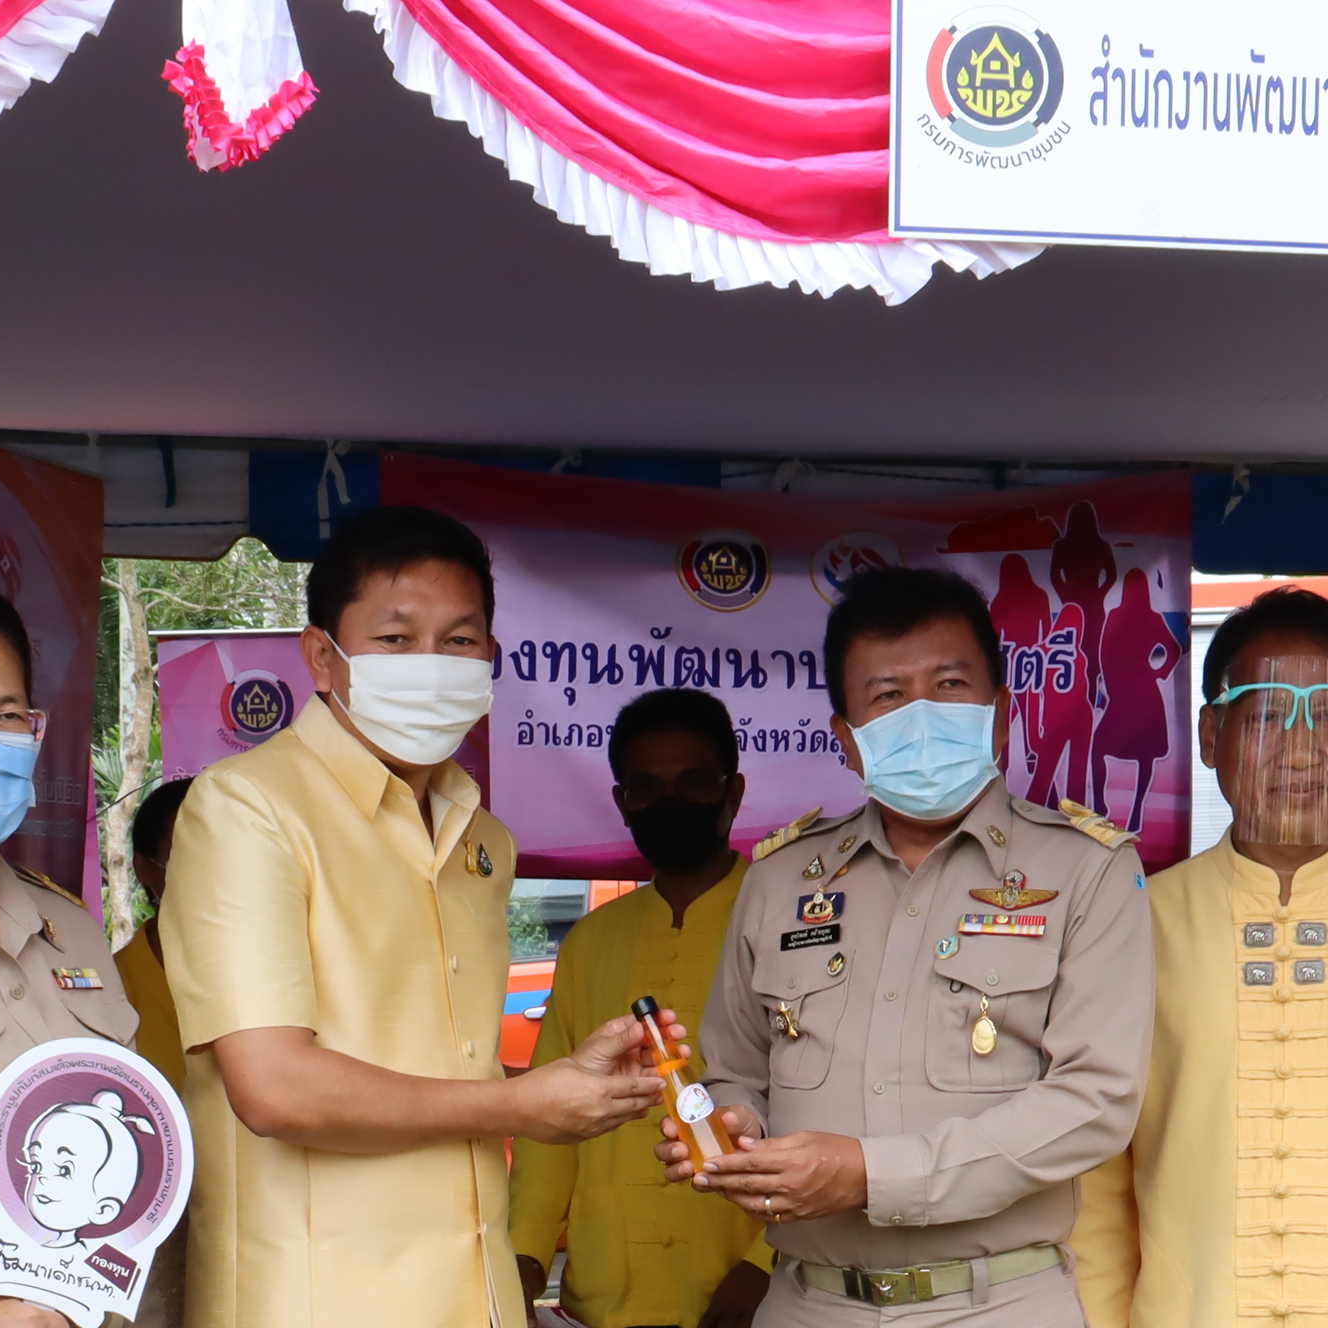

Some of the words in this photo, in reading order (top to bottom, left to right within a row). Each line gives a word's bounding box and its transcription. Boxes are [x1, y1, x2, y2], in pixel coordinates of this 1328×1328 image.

[916, 112, 1073, 170] กรมการพัฒนาชุมชน
[517, 709, 615, 748] อำเภอ
[90, 1253, 132, 1278] กองทุน
